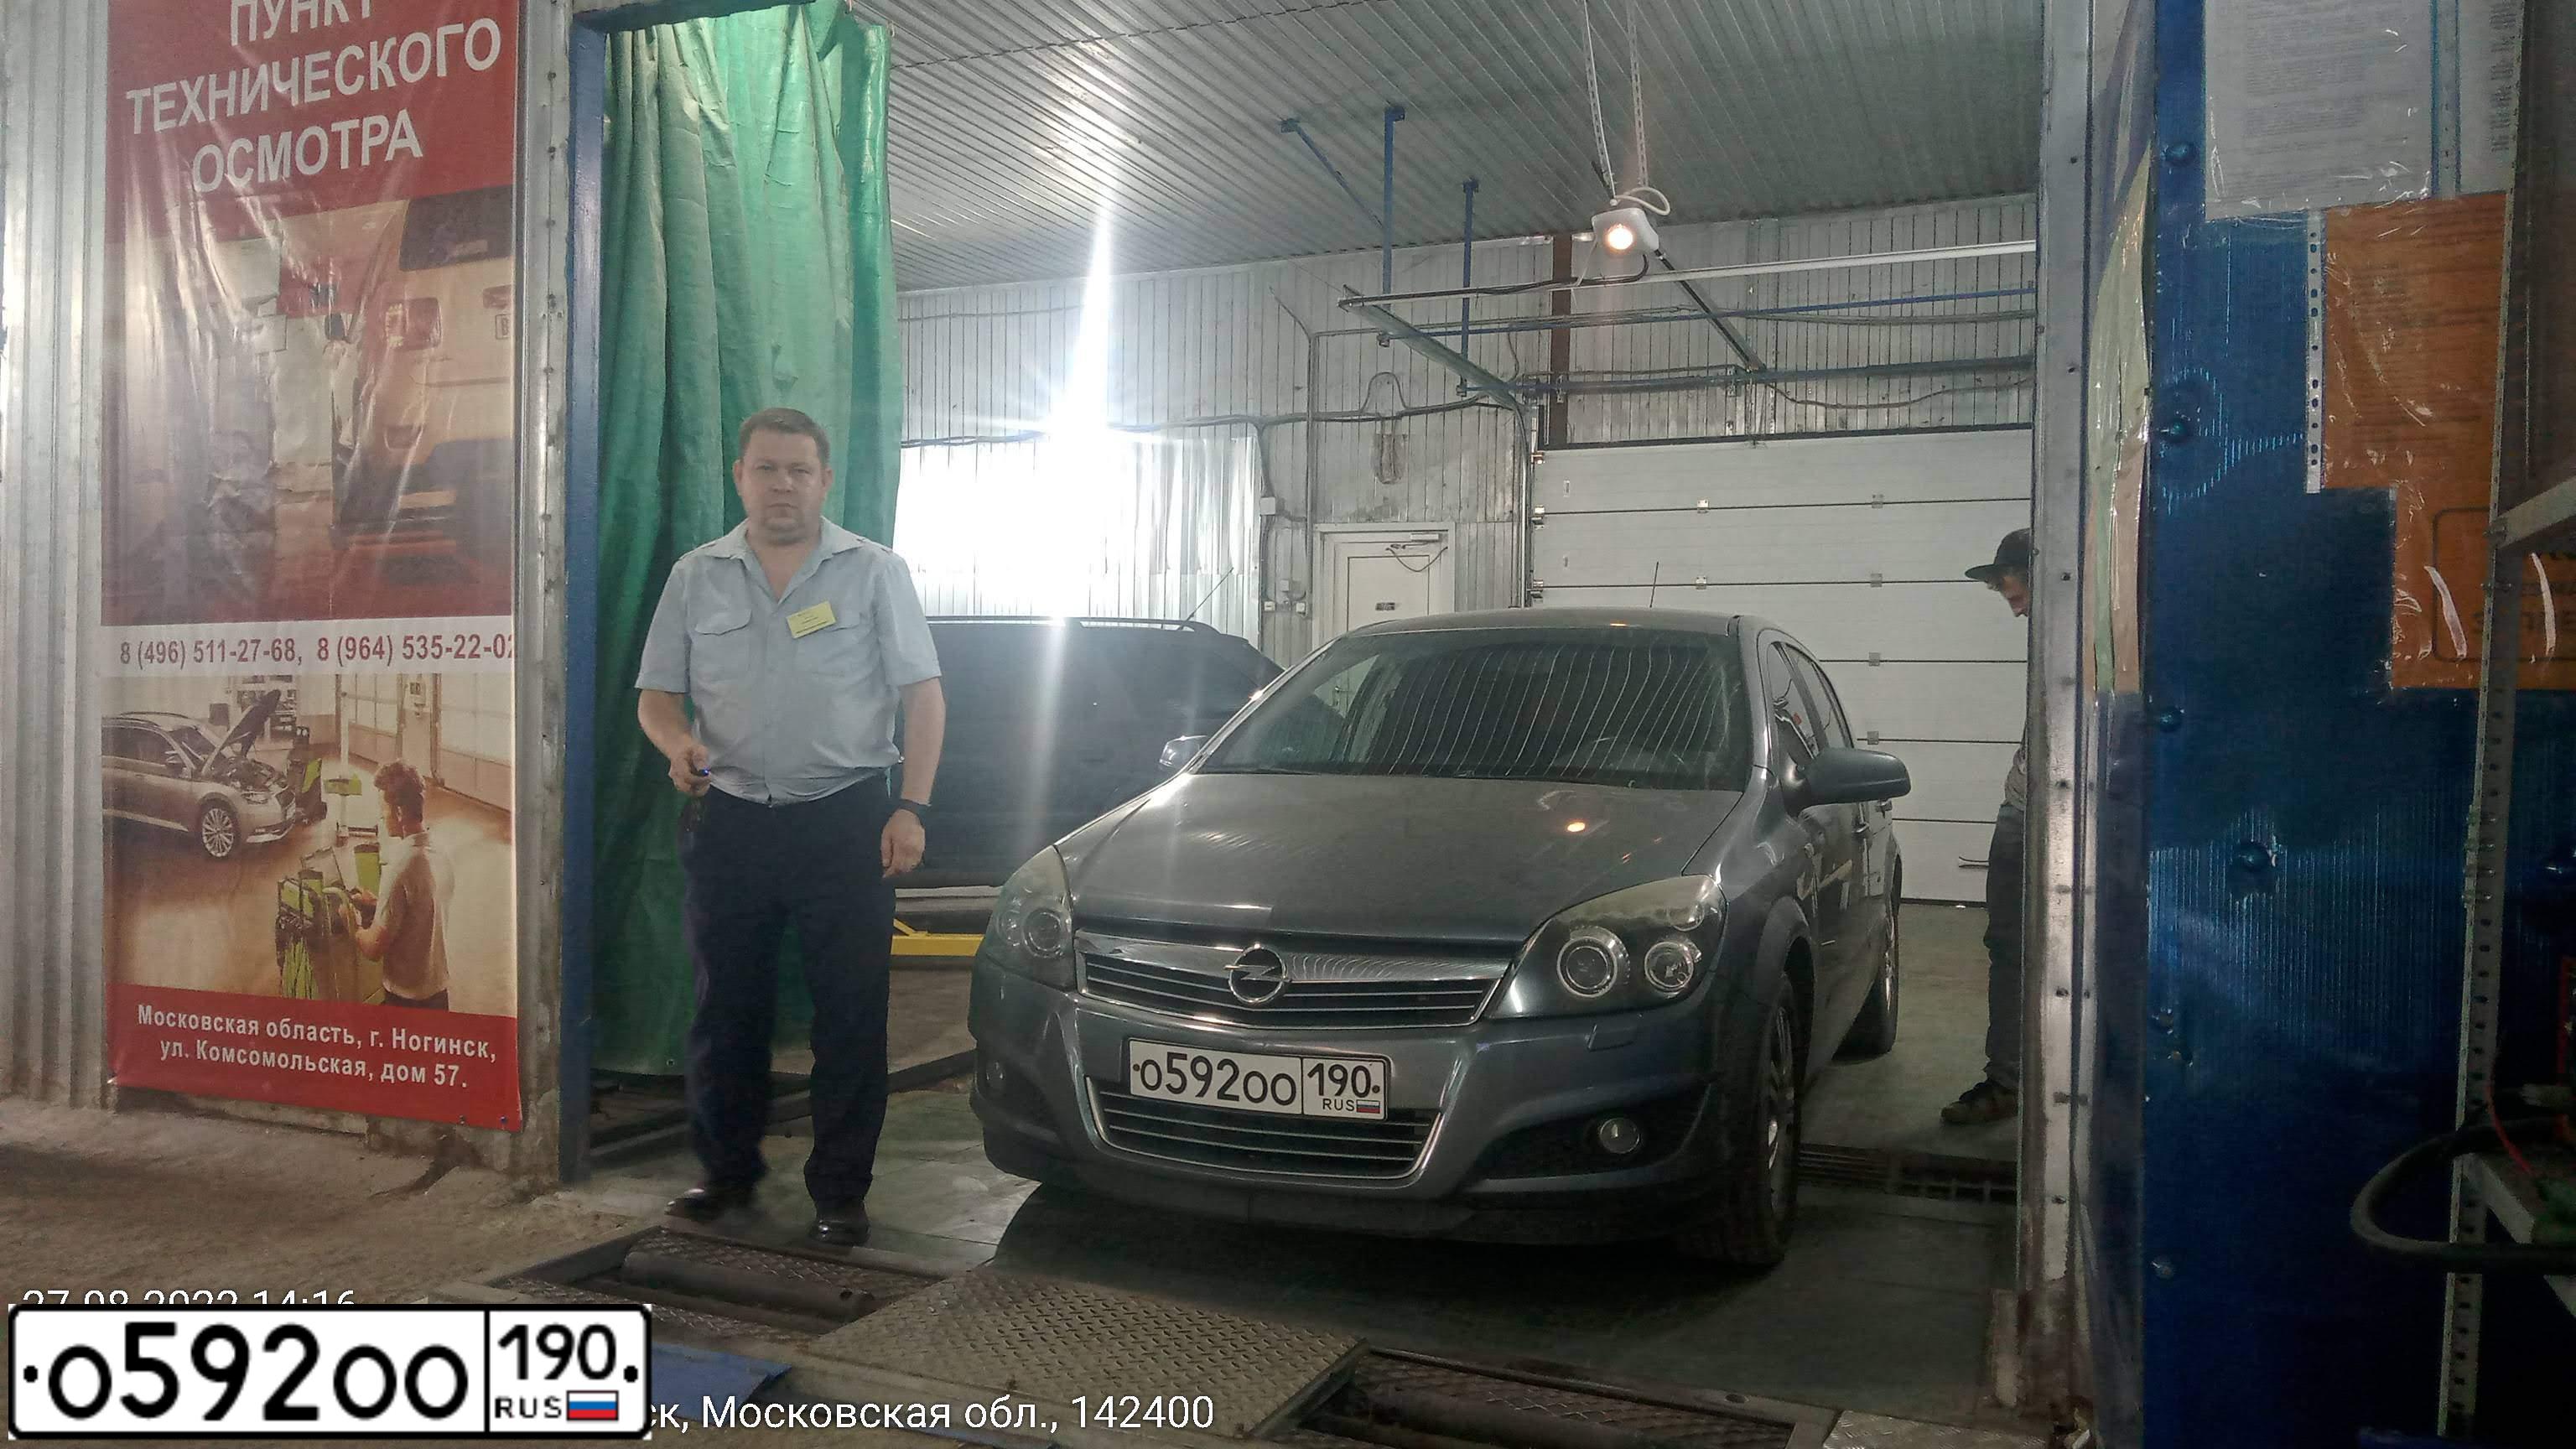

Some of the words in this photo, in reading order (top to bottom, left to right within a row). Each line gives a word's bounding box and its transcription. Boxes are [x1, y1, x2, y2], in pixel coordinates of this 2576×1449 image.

[126, 18, 501, 134] ТЕХНИЧЕСКОГО
[192, 108, 423, 193] ОСМОТРА
[120, 641, 132, 664] 8
[137, 639, 186, 670] (496)
[193, 637, 303, 666] 511-27-68,
[317, 636, 329, 661] 8
[336, 634, 393, 667] (964)
[138, 1005, 259, 1036] Московская
[267, 1018, 362, 1048] область,
[370, 1031, 383, 1047] г.
[392, 1028, 496, 1062] Ногинск,
[160, 1039, 190, 1061] ул.
[196, 1040, 374, 1081] Комсомольская,
[381, 1062, 426, 1087] дом
[434, 1063, 467, 1088] 57.
[1307, 1062, 1372, 1098] 190
[1322, 1098, 1355, 1112] RUS
